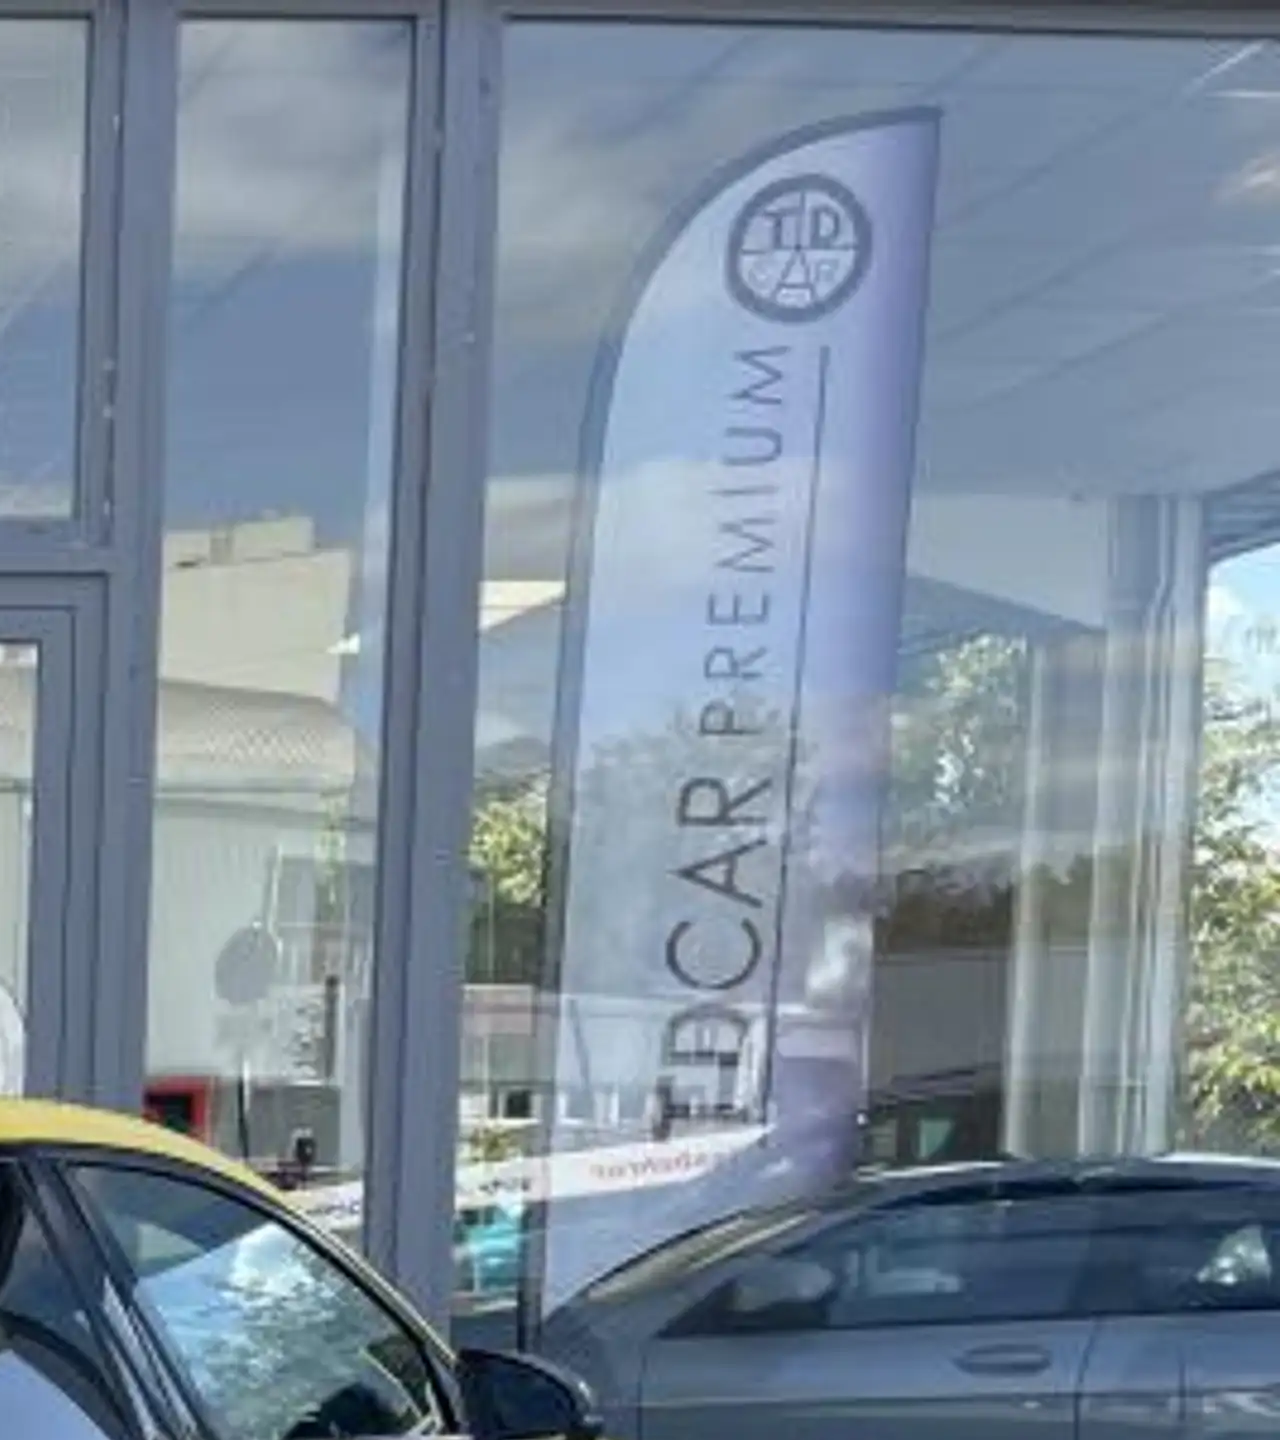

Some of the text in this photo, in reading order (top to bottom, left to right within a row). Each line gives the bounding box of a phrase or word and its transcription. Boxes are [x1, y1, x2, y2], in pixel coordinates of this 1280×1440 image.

[762, 203, 840, 250] TD
[698, 344, 791, 738] PREMIUM
[652, 775, 776, 1142] TDCAR
